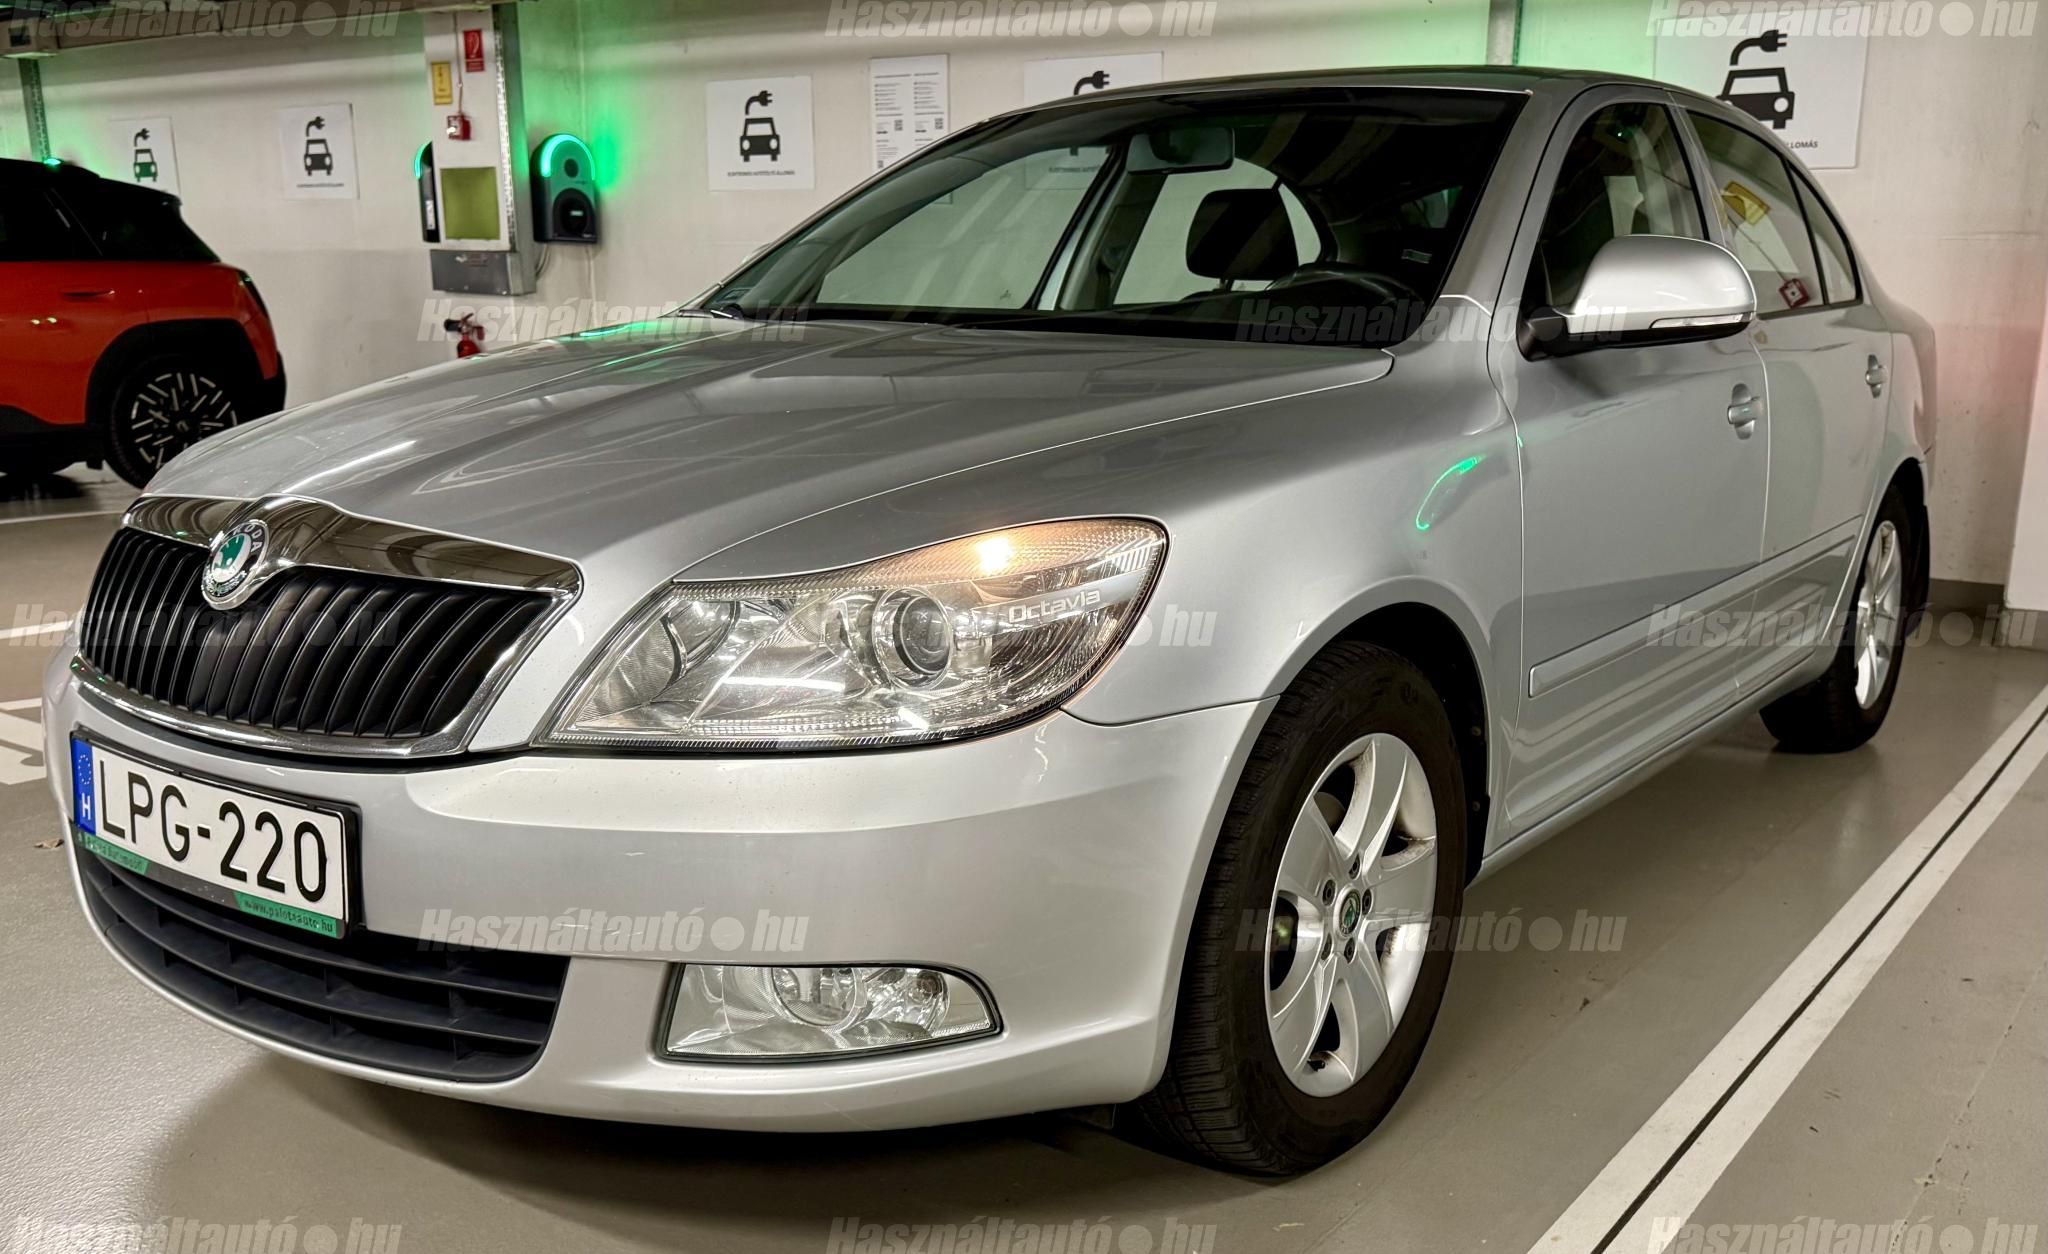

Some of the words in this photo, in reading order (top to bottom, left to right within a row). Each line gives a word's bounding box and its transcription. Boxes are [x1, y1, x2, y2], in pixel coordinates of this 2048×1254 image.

[1008, 590, 1100, 623] Octavia
[81, 792, 91, 820] H
[99, 759, 328, 903] LPG-220
